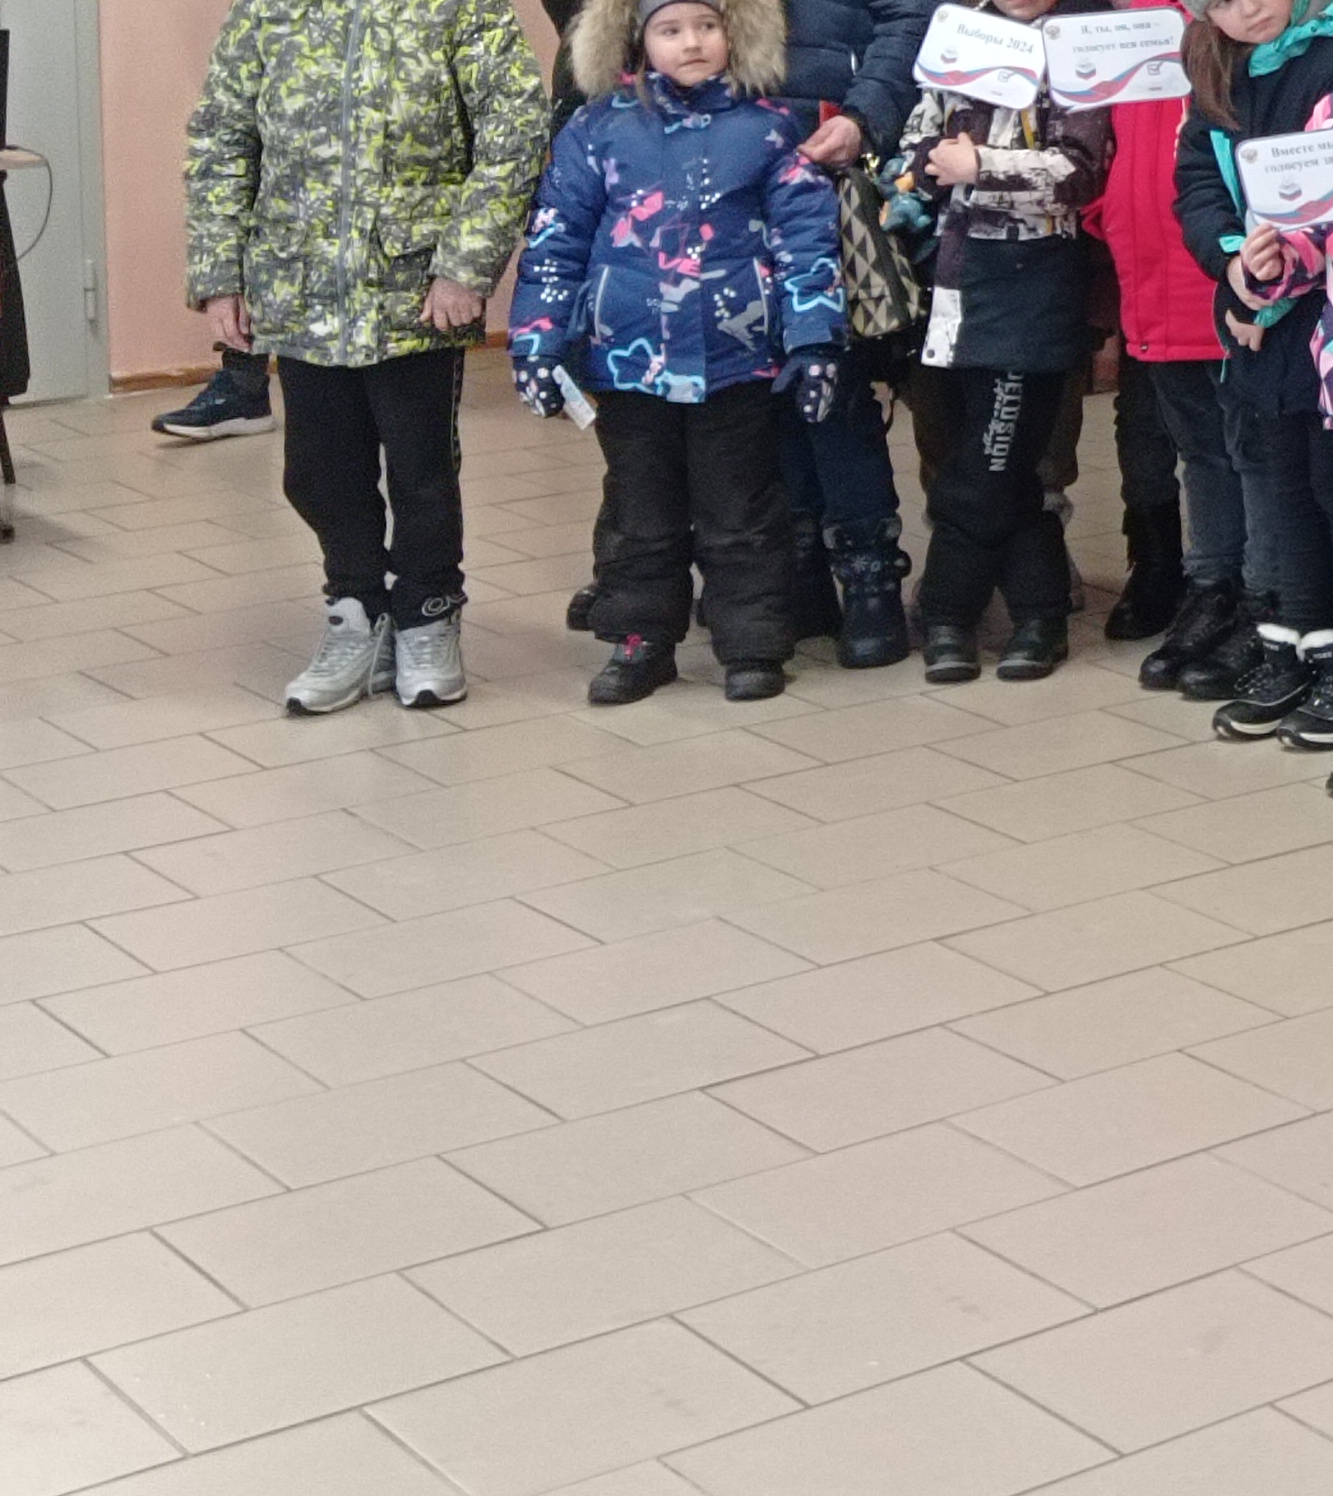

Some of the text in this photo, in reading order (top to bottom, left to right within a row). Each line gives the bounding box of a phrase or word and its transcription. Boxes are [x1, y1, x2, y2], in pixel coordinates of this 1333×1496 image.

[957, 23, 1034, 54] Выборы 2024
[1271, 144, 1315, 158] Вместе
[1264, 159, 1319, 174] голосуем
